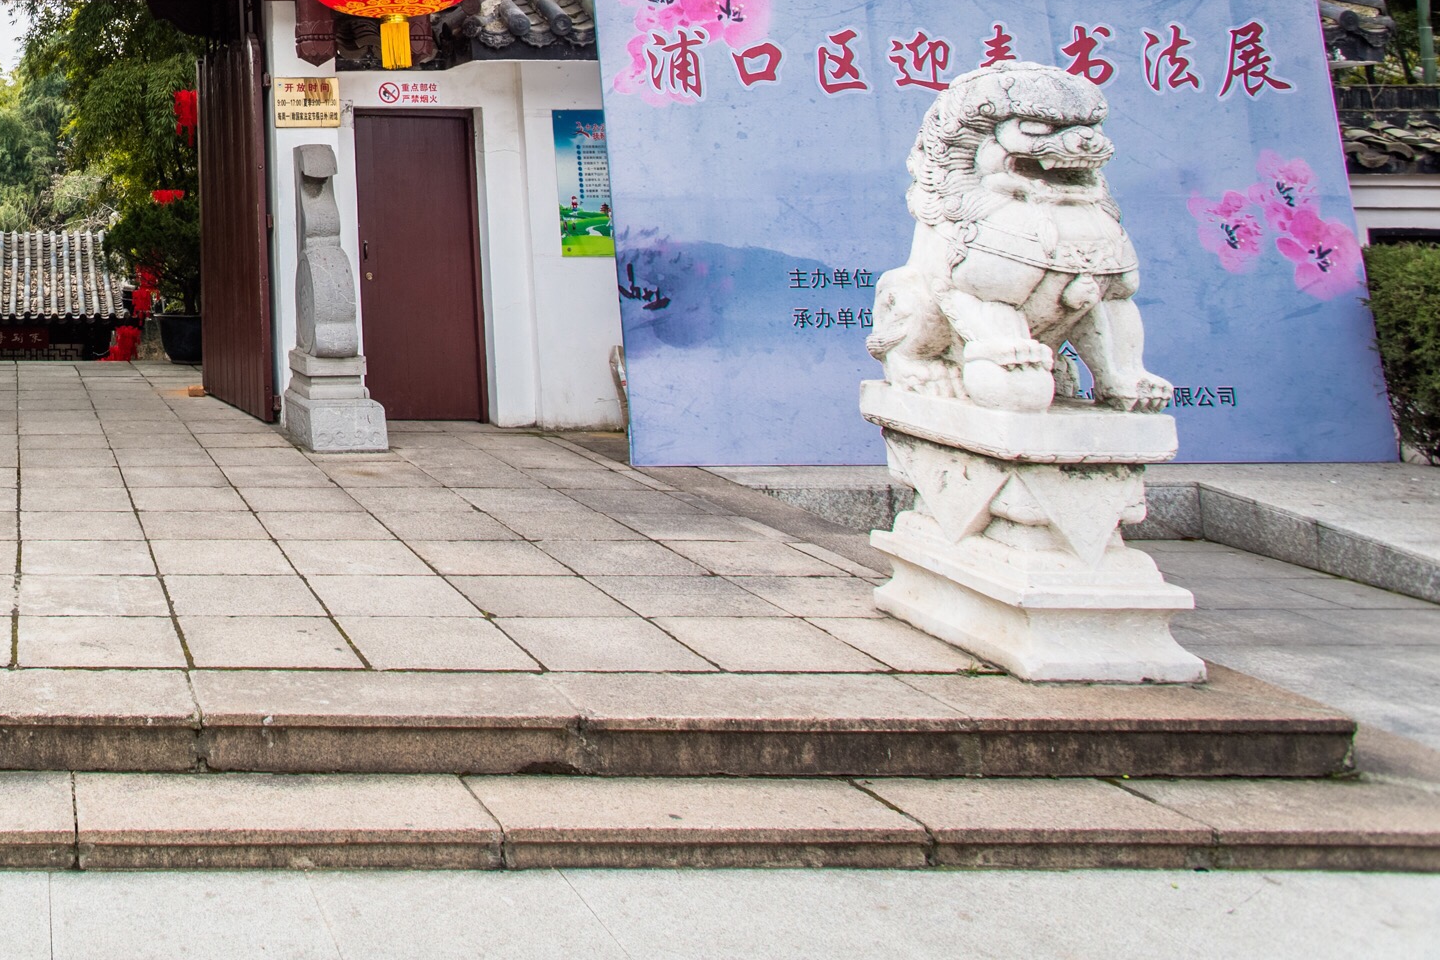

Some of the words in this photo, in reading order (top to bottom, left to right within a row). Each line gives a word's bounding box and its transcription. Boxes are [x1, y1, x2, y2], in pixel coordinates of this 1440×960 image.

[284, 82, 330, 93] 开放时间
[401, 83, 437, 92] 重点部位
[402, 94, 437, 103] 严禁烟火
[793, 307, 873, 328] 承办单位
[1166, 386, 1236, 408] 限公司
